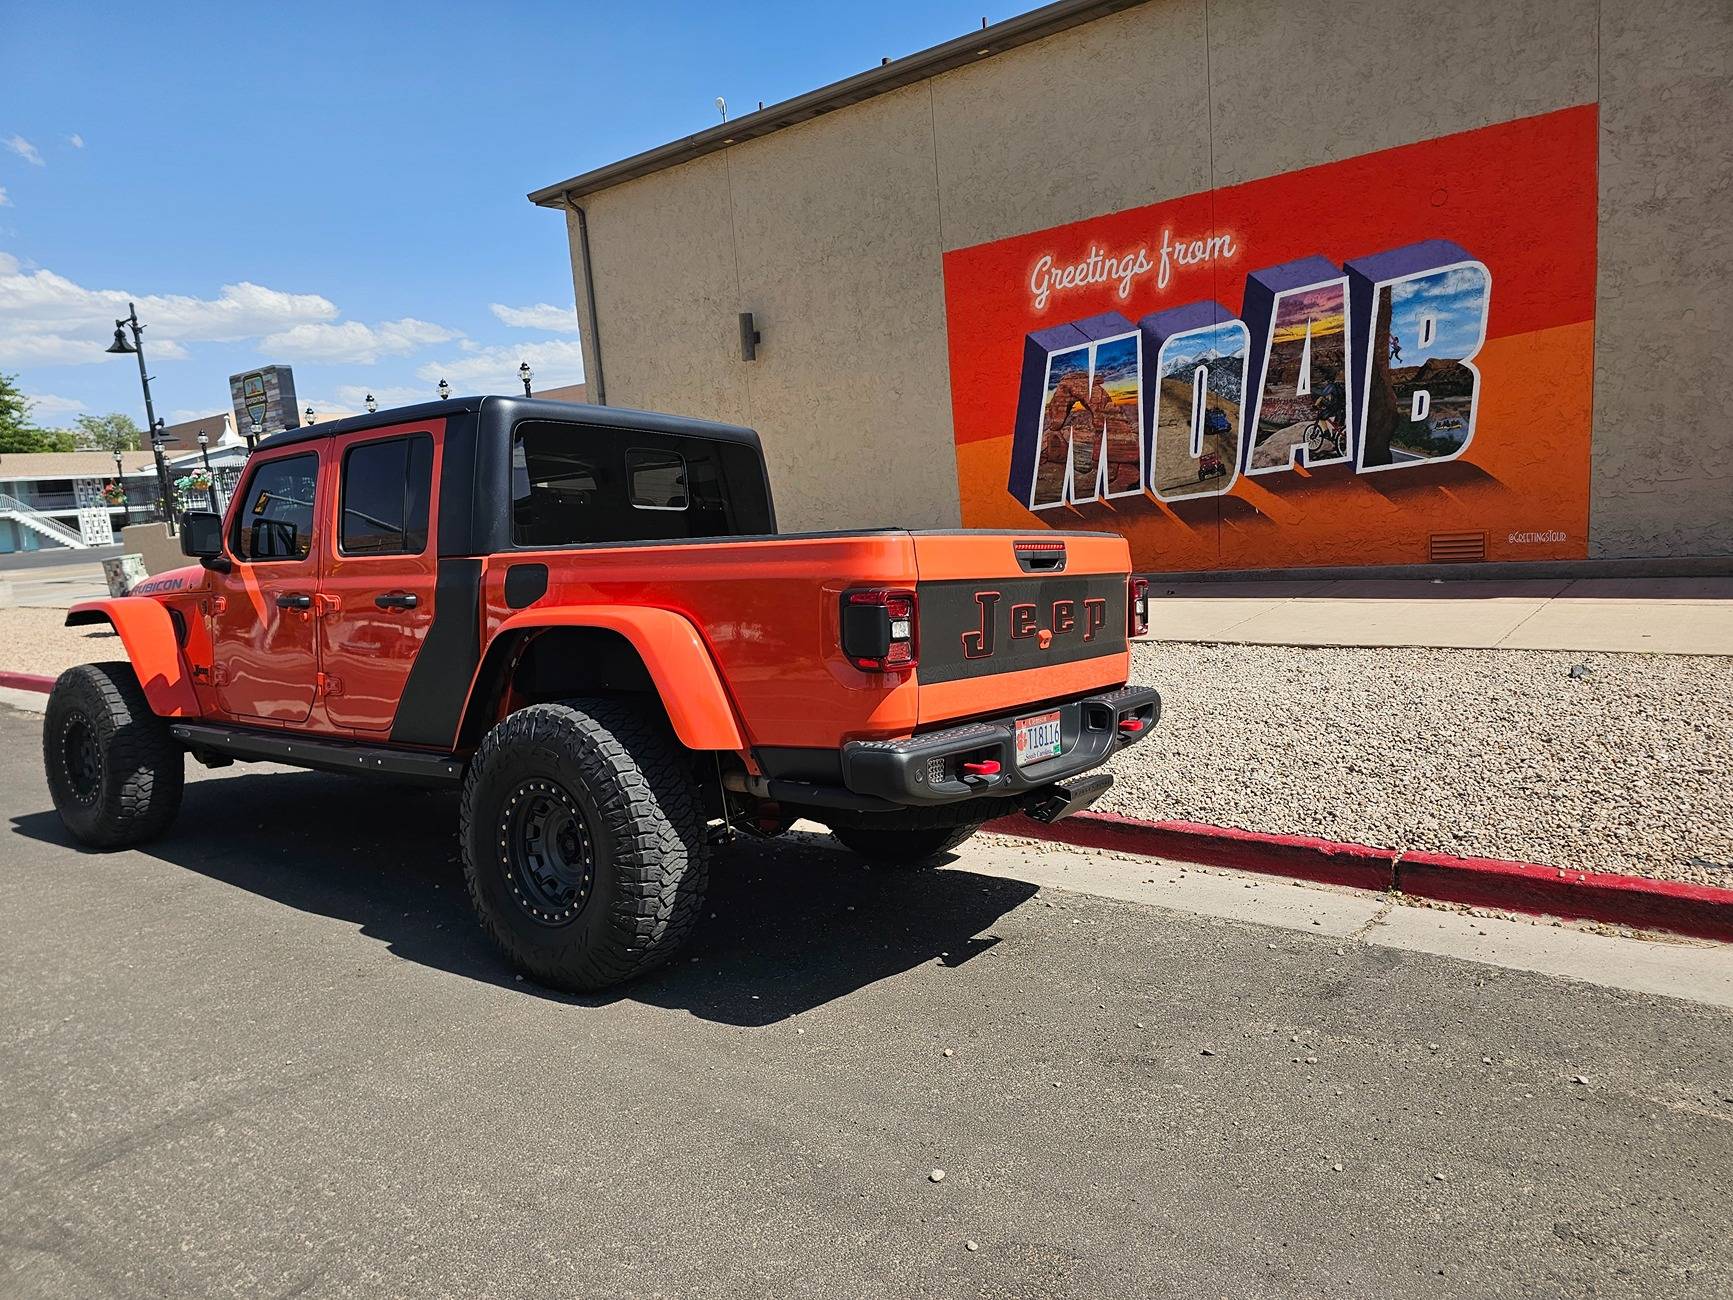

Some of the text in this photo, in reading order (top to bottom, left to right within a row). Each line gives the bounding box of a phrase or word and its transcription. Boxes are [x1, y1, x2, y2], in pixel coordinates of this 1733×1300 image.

[1030, 229, 1236, 309] Greetings from
[1028, 260, 1492, 511] MOAB
[132, 578, 183, 595] RUBICON
[961, 591, 1106, 660] Jeep
[1028, 723, 1060, 749] T18116
